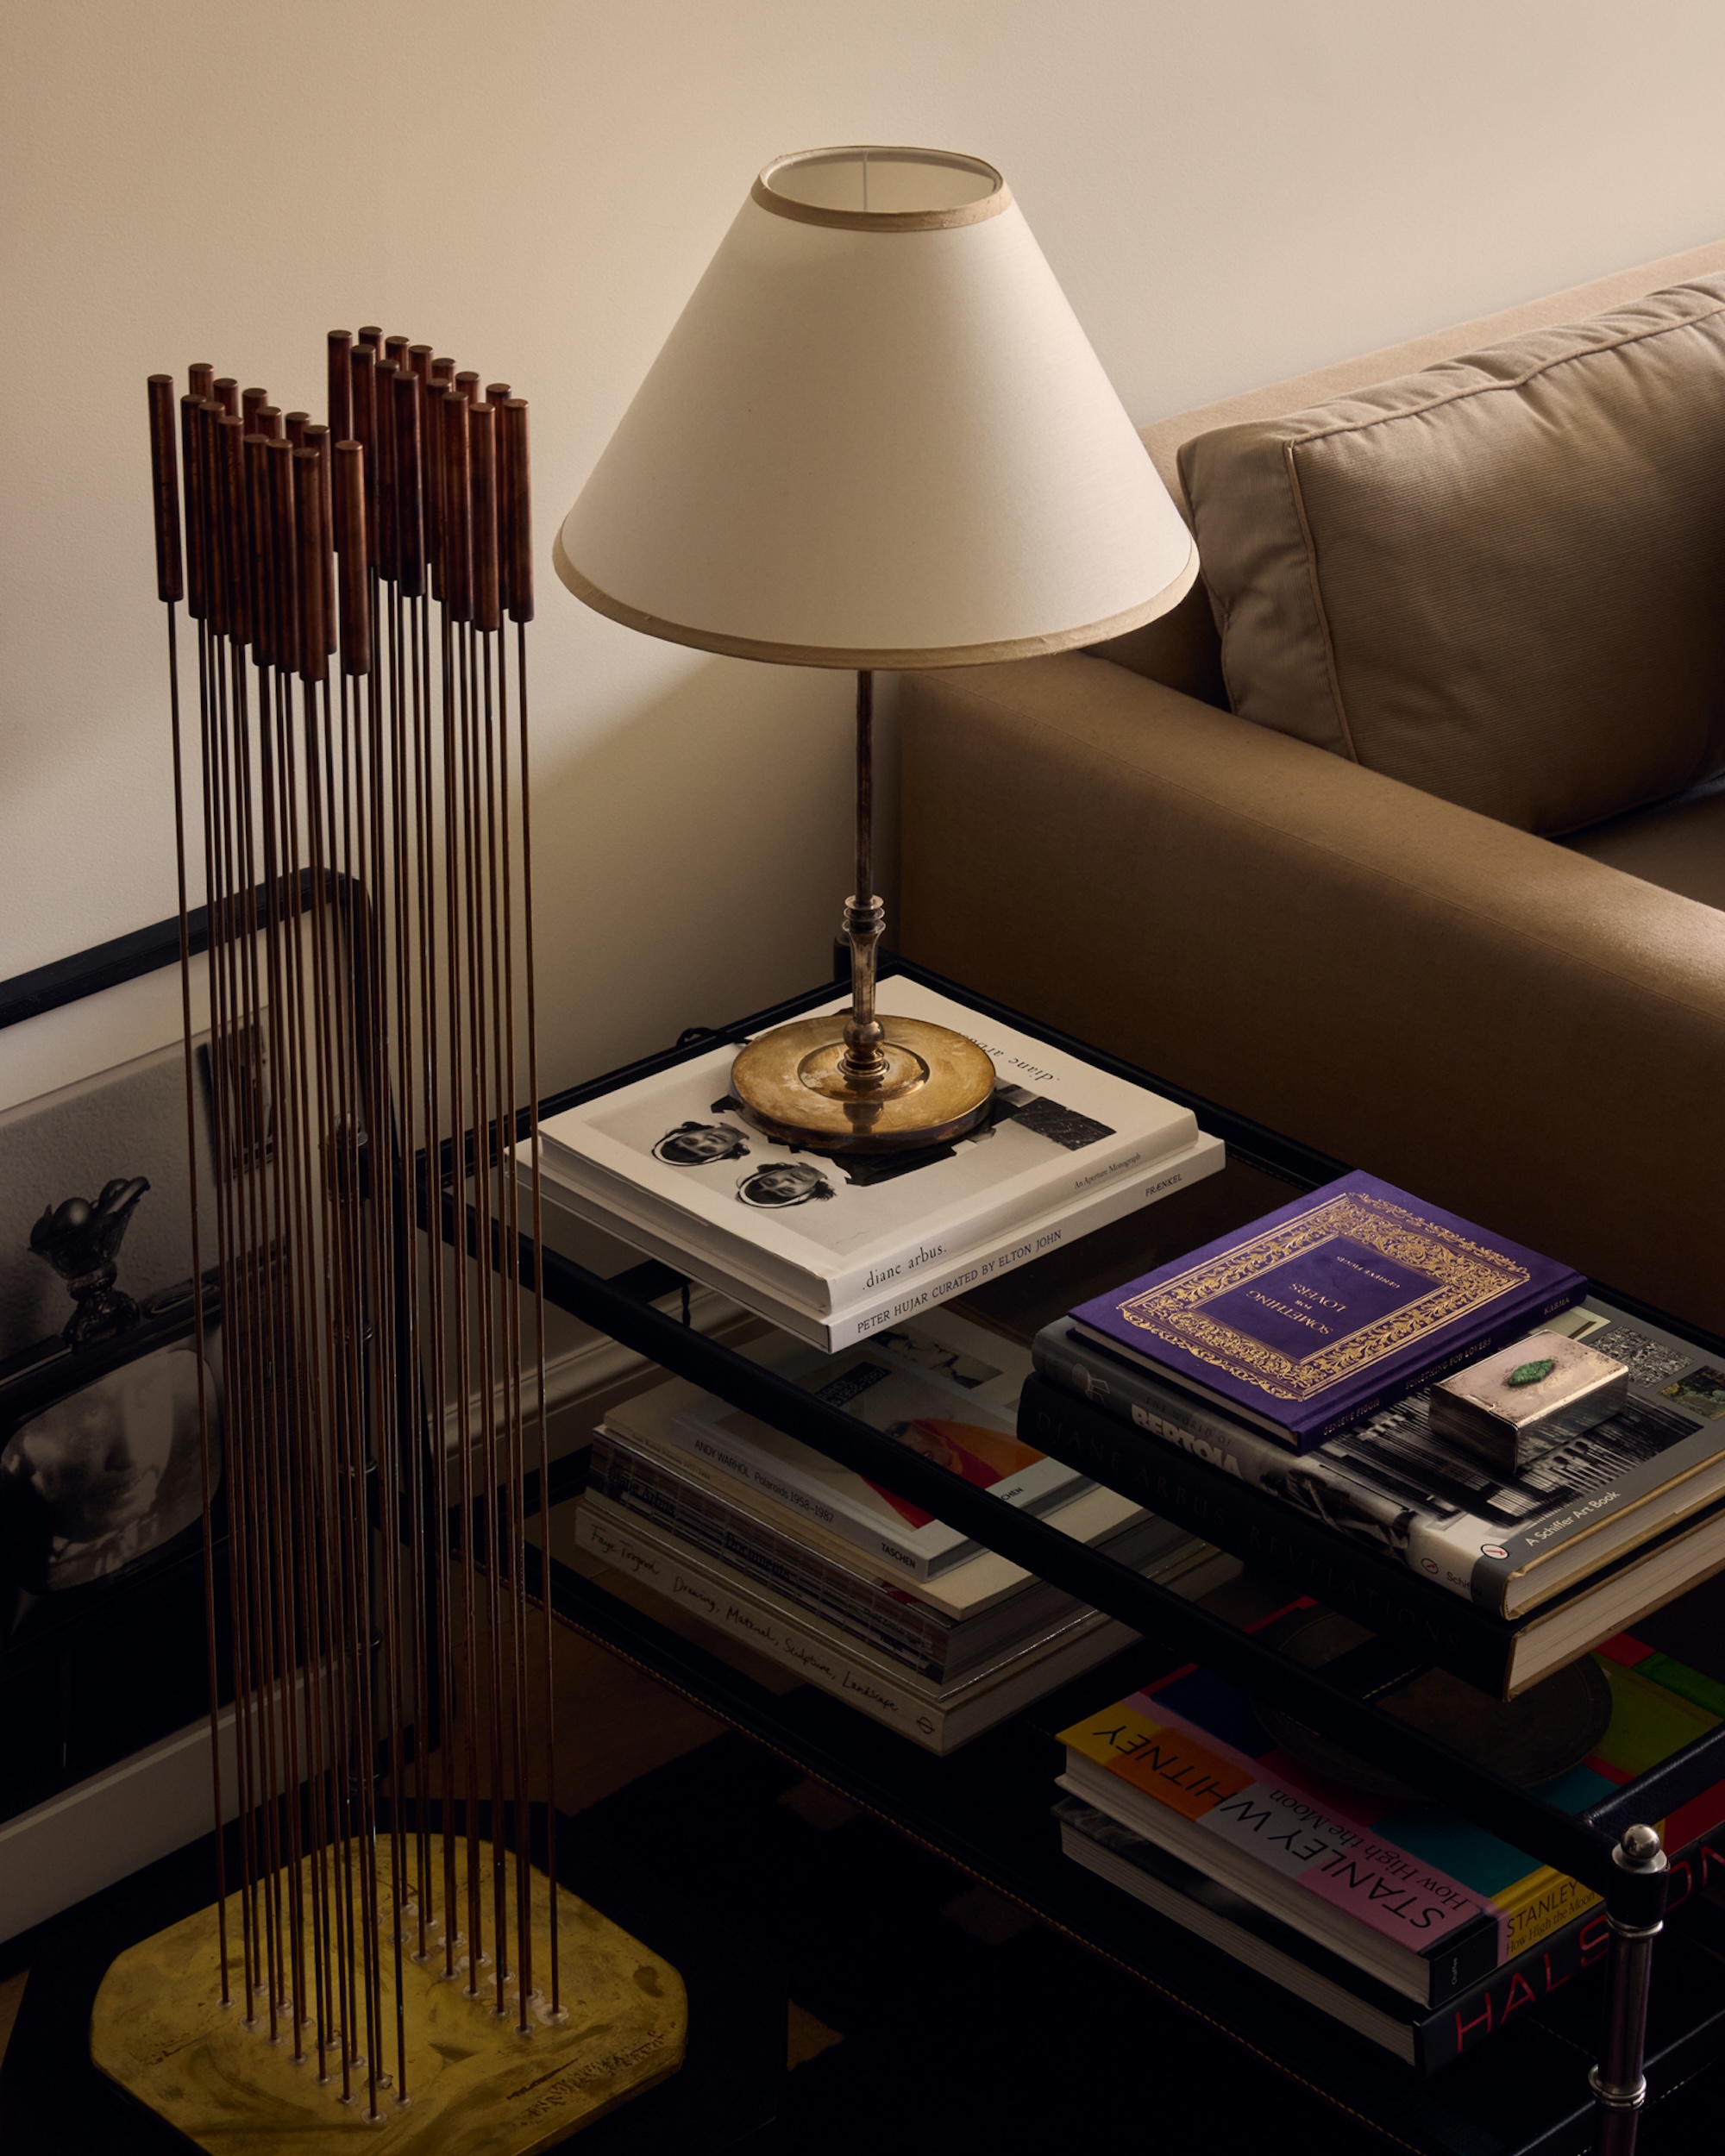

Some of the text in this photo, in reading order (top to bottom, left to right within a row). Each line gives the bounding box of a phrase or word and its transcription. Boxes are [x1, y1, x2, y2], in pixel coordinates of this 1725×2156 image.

[1074, 1152, 1141, 1189] An Aperture Monograph
[856, 1230, 1062, 1334] PETER HUJAR CURATED BY ELTON JOHN
[908, 1244, 947, 1269] arbus.
[1245, 1290, 1334, 1335] SOMETHING
[1289, 1282, 1347, 1313] LOVERS
[1544, 1296, 1571, 1316] KARMA
[1356, 1398, 1380, 1418] FIGGIS
[1405, 1361, 1449, 1390] SOMETHING
[1449, 1353, 1464, 1367] FOR
[1465, 1338, 1492, 1358] LOVERS
[1131, 1403, 1243, 1480] BERTOIA
[1145, 1396, 1233, 1447] THE WORLD OF
[693, 1438, 717, 1459] ANDY
[717, 1452, 750, 1477] WARHOL
[754, 1471, 789, 1500] Polaroids
[1000, 1487, 1024, 1501] CHEN
[1037, 1411, 1459, 1653] DIANE ARBUS REVELATIONS
[1525, 1490, 1621, 1547] A Schiffer Art Book
[881, 1542, 915, 1569] TASCHEN
[1446, 1571, 1483, 1595] Schiffer
[591, 1524, 617, 1552] Faye
[842, 1671, 899, 1711] Landscape
[1093, 1725, 1446, 1929] STANLEY WHITNEY
[1270, 1789, 1470, 1911] How High the Moon
[1506, 1890, 1596, 1955] How High the Moon
[1507, 1879, 1579, 1939] STANLEY
